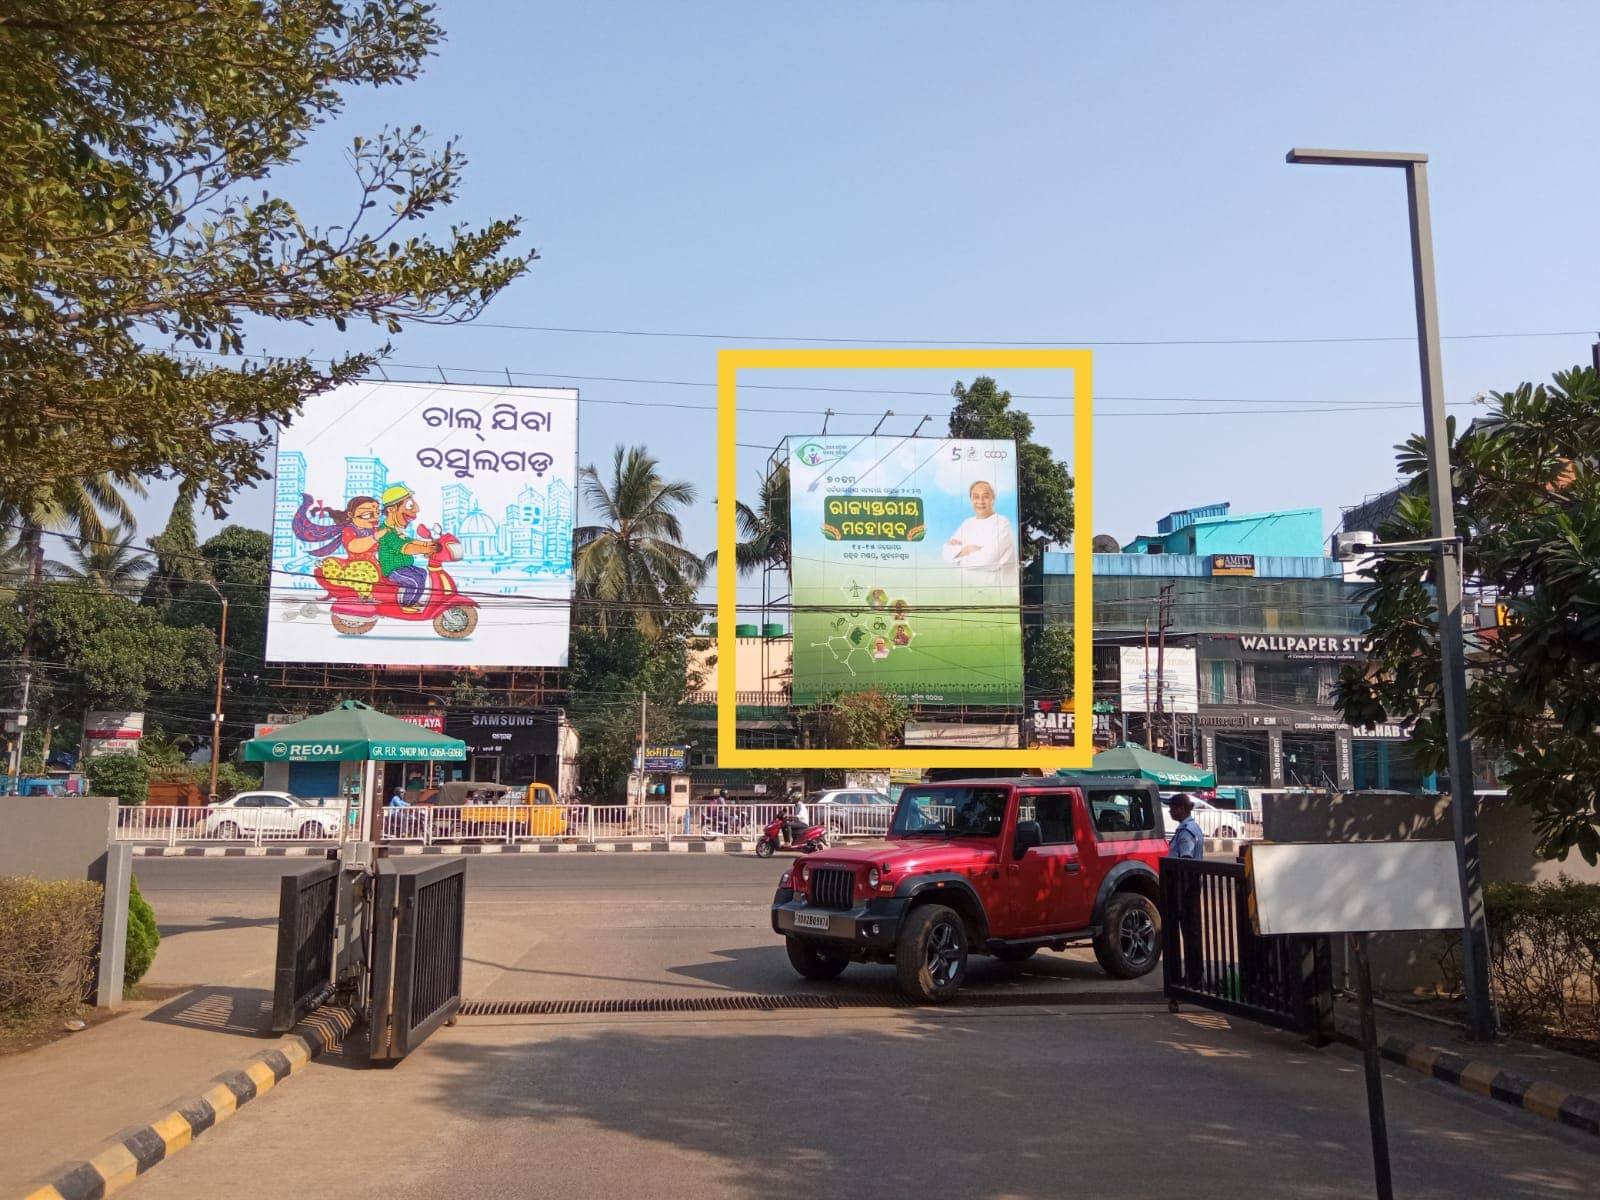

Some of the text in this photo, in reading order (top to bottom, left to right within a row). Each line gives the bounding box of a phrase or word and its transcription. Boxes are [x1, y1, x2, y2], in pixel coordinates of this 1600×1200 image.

[422, 404, 552, 441] ଚାଲ୍ ଯିବା
[416, 447, 554, 479] ରସୁଲଗଡ଼
[828, 500, 919, 516] ରାଜ୍ୟସ୍ତରୀୟ
[1224, 556, 1252, 566] AMITY
[1240, 635, 1339, 652] WALLPAPER
[472, 715, 534, 726] SAMSUNG
[1033, 712, 1110, 731] SAFFON
[290, 744, 343, 756] REGAL
[399, 746, 417, 758] SHOP
